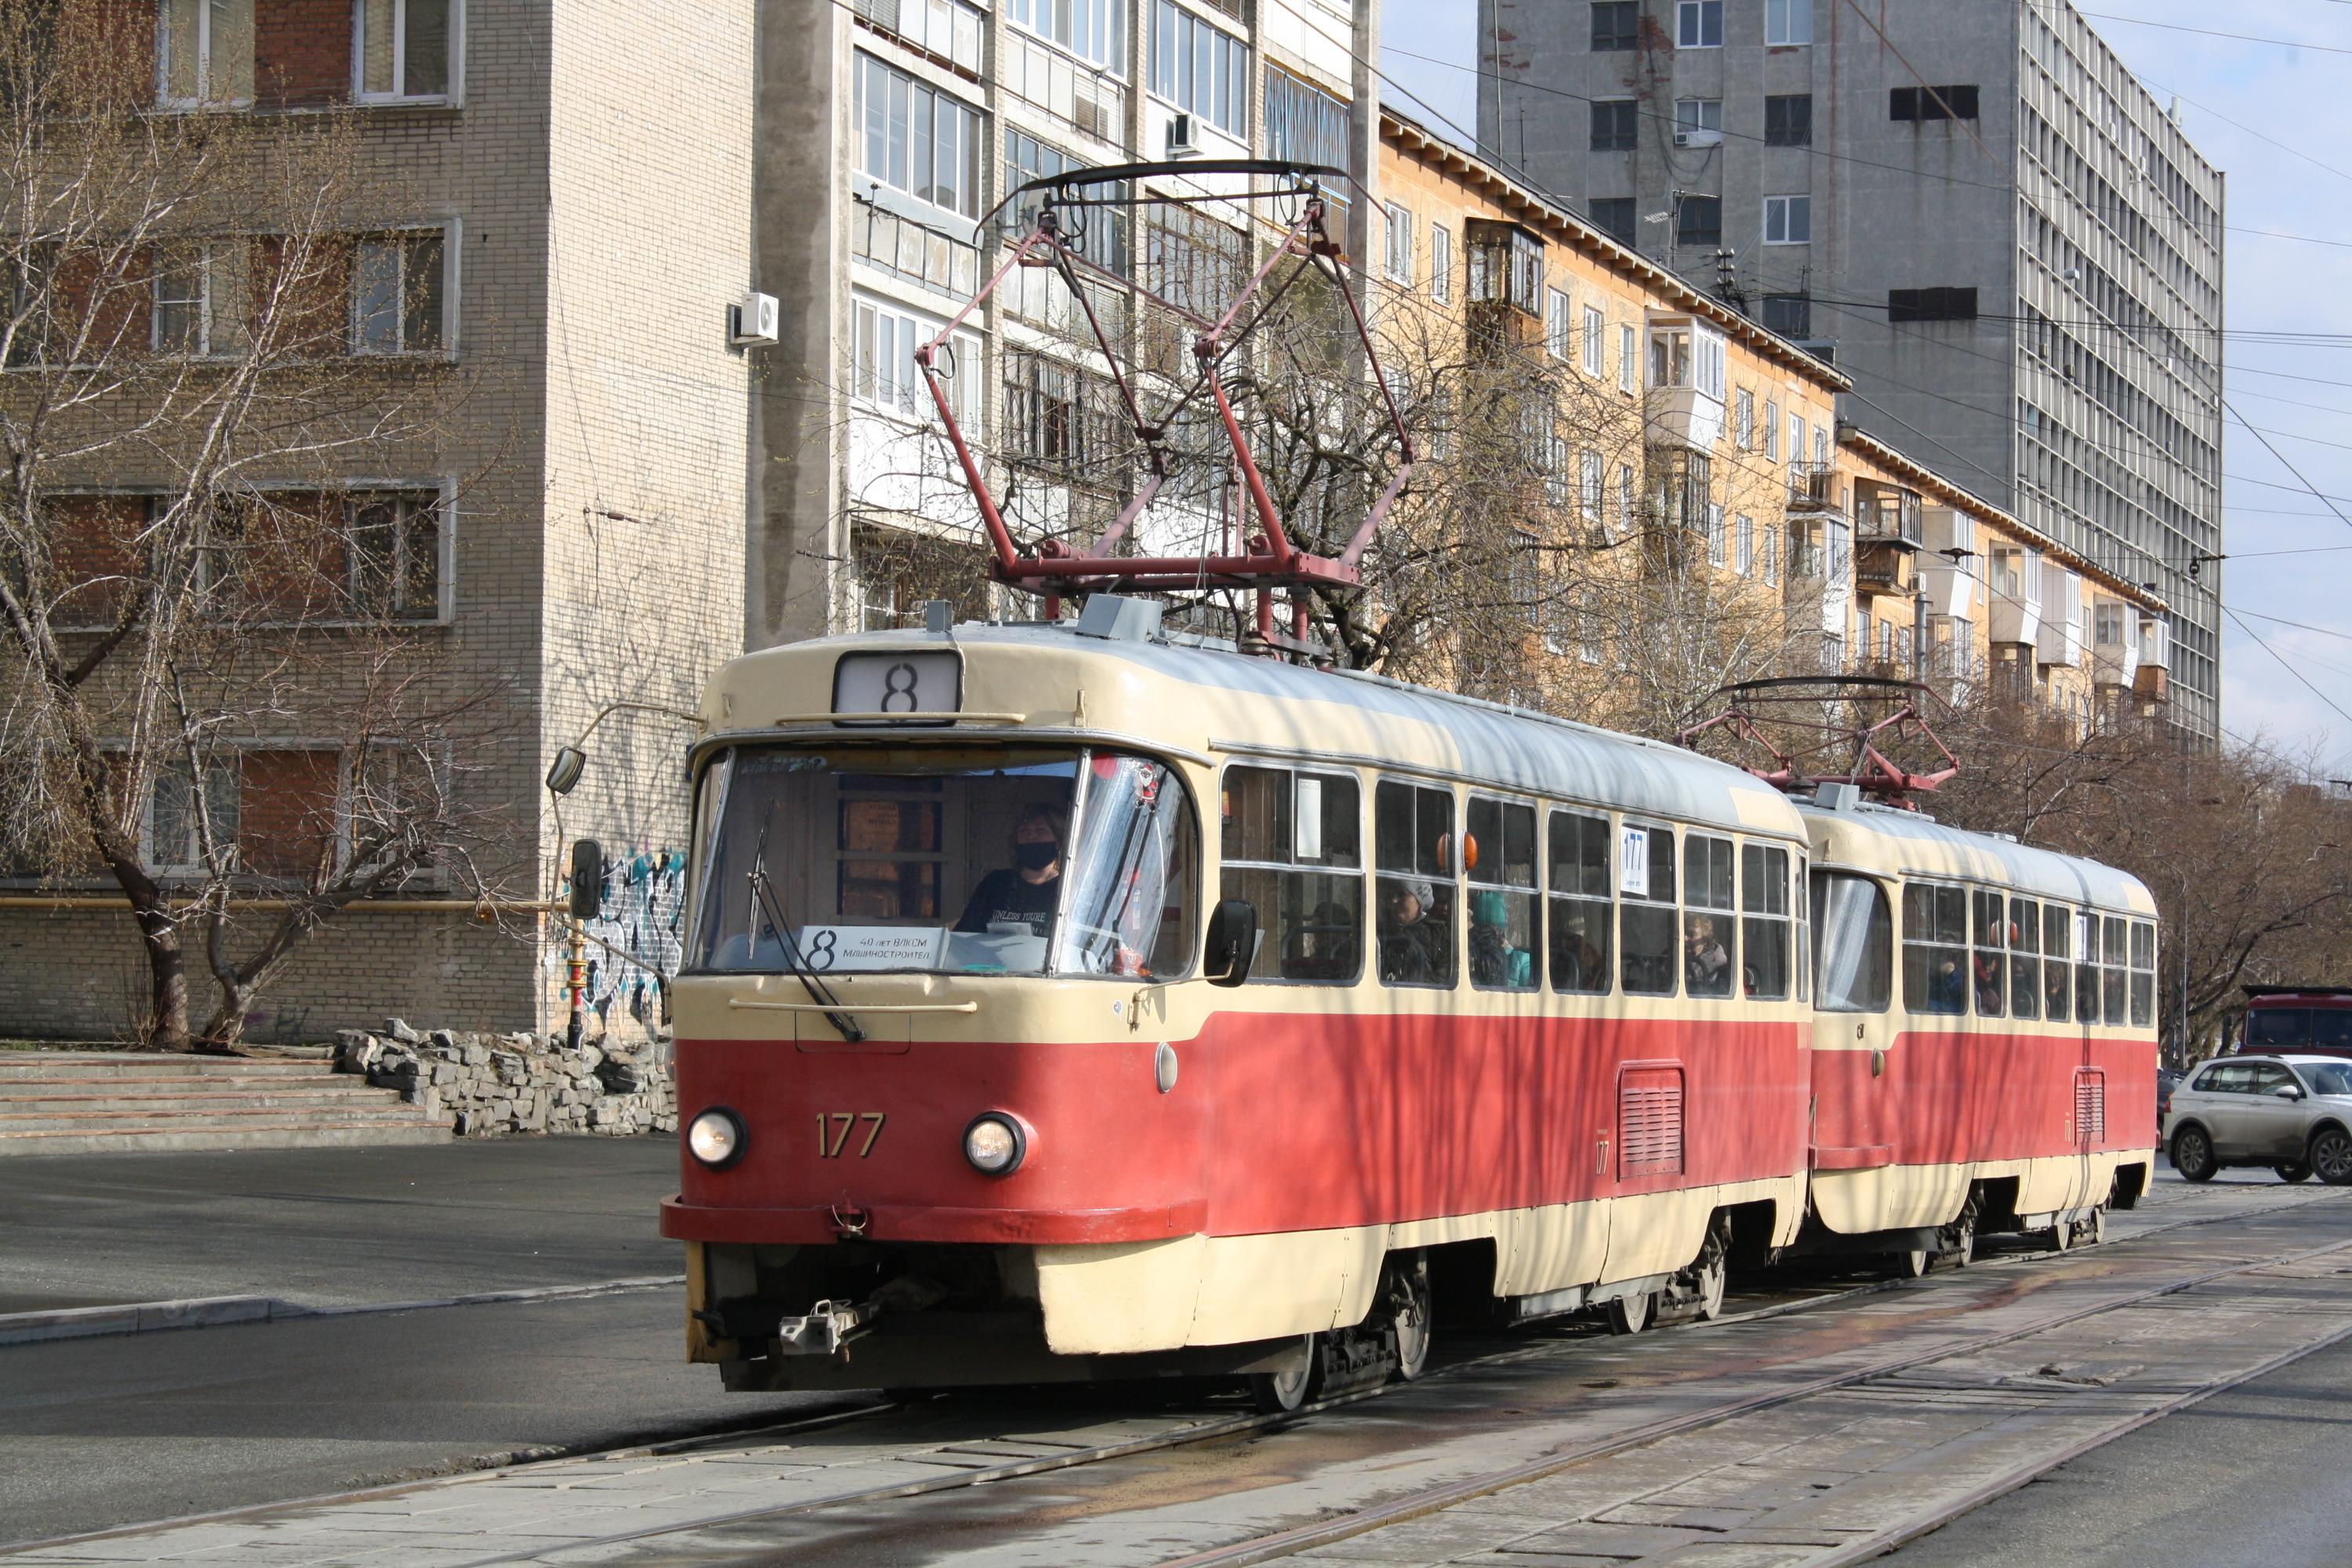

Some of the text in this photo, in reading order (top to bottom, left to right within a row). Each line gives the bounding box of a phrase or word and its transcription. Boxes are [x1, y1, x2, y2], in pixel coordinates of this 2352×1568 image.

[880, 662, 918, 723] 8
[1624, 833, 1643, 870] 177
[992, 909, 1021, 921] UNLESS
[806, 930, 837, 971] 8
[860, 938, 874, 946] 40
[893, 938, 927, 948] ВЛКСМ
[816, 1112, 885, 1157] 177
[1596, 1141, 1609, 1174] 177
